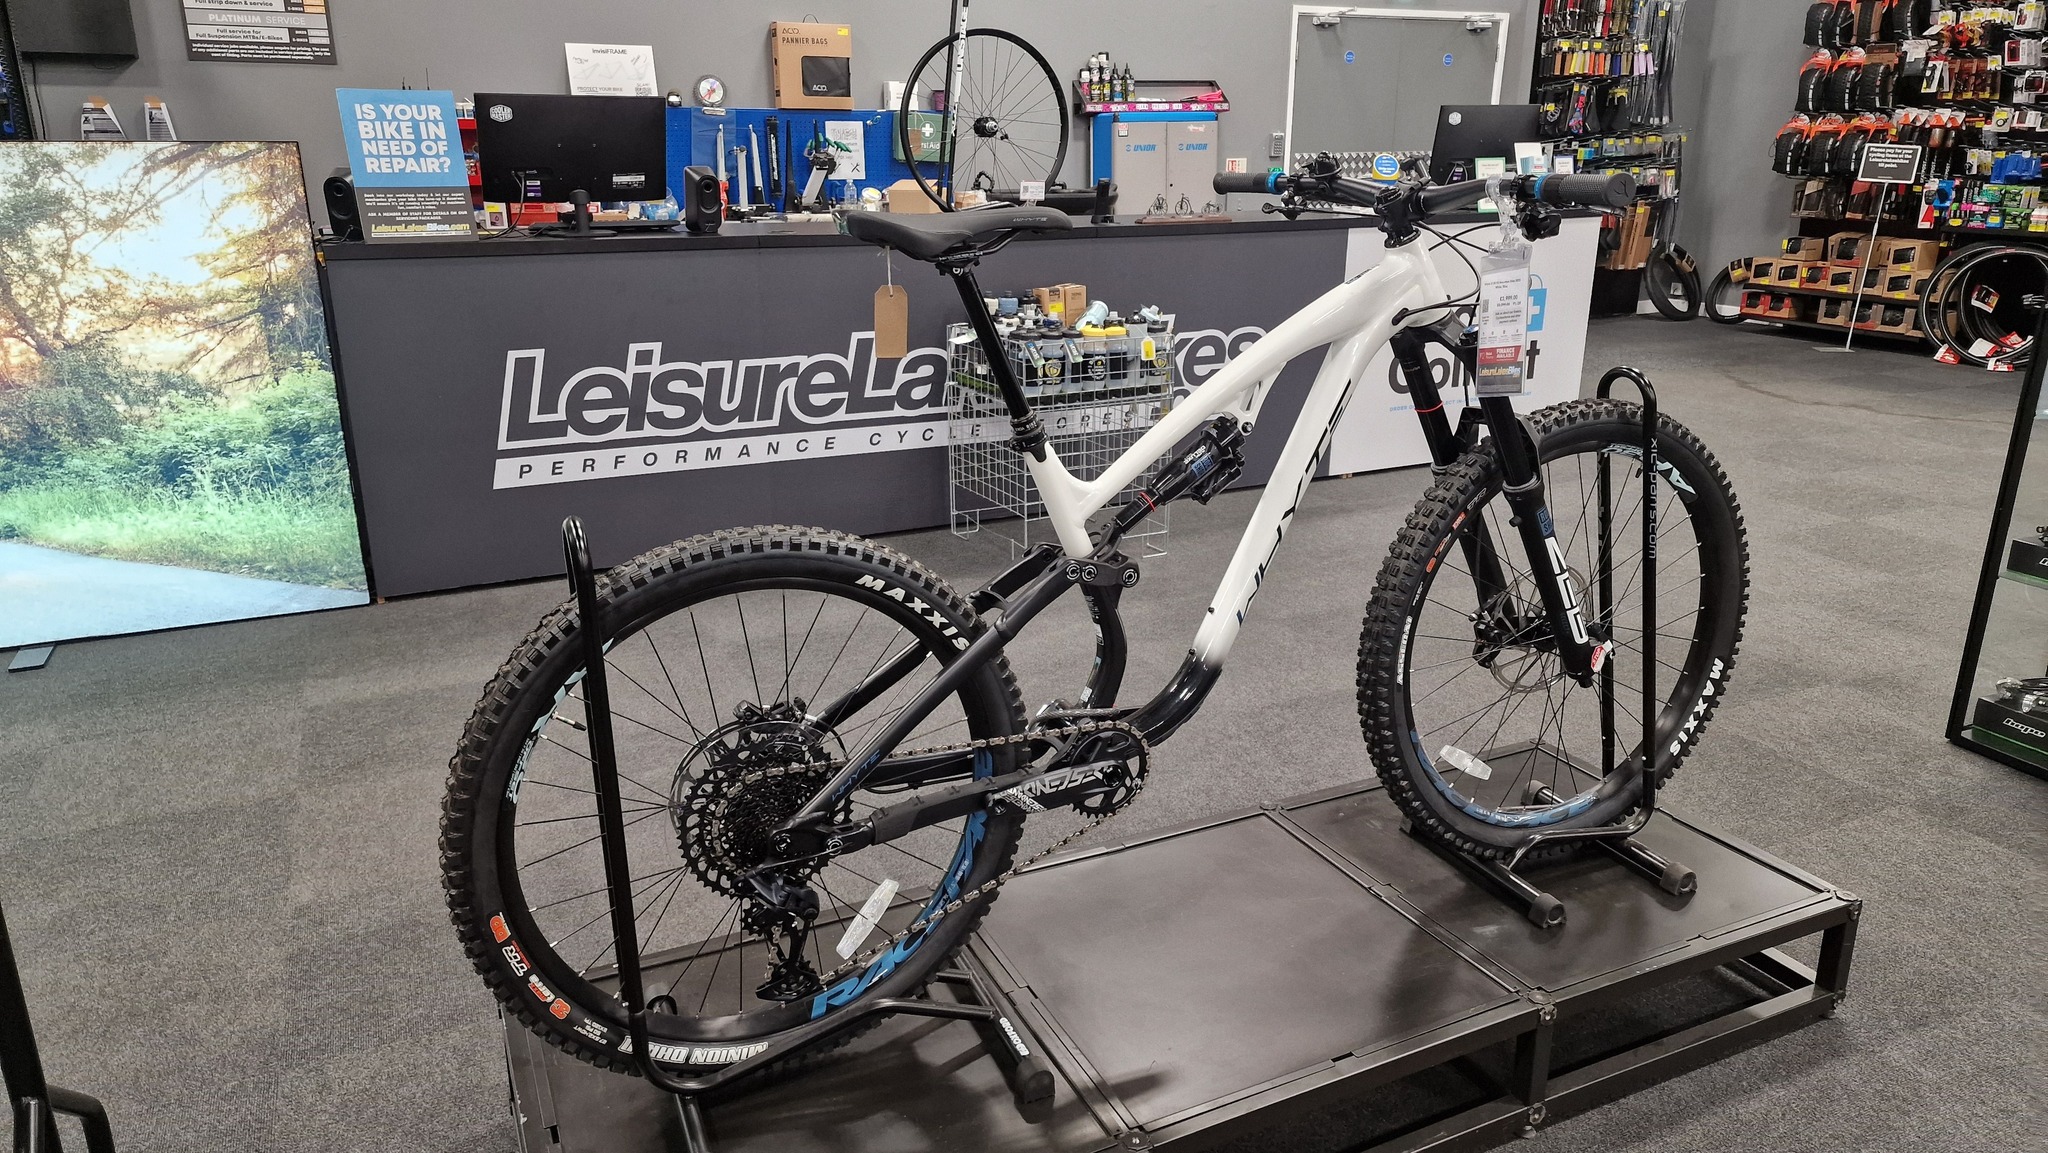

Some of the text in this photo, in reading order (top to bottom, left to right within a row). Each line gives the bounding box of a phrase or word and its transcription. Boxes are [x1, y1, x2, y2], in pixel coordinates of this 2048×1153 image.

[208, 13, 306, 25] PLATINUM SERVICE
[782, 37, 810, 45] PANNIER
[354, 103, 442, 121] IS YOUR
[491, 105, 511, 113] COOLER
[358, 121, 447, 140] BIKE IN
[361, 141, 448, 156] NEED OF
[1133, 144, 1157, 152] UNIOR
[1186, 143, 1208, 151] UNIOR
[364, 157, 451, 173] REPAIR?
[519, 436, 836, 479] PERFORMANCE
[854, 574, 971, 651] MAXXIS
[1669, 657, 1725, 756] MAXXIS
[2003, 717, 2046, 738] hope
[832, 751, 881, 801] WHYTE
[689, 1042, 769, 1065] MINION
